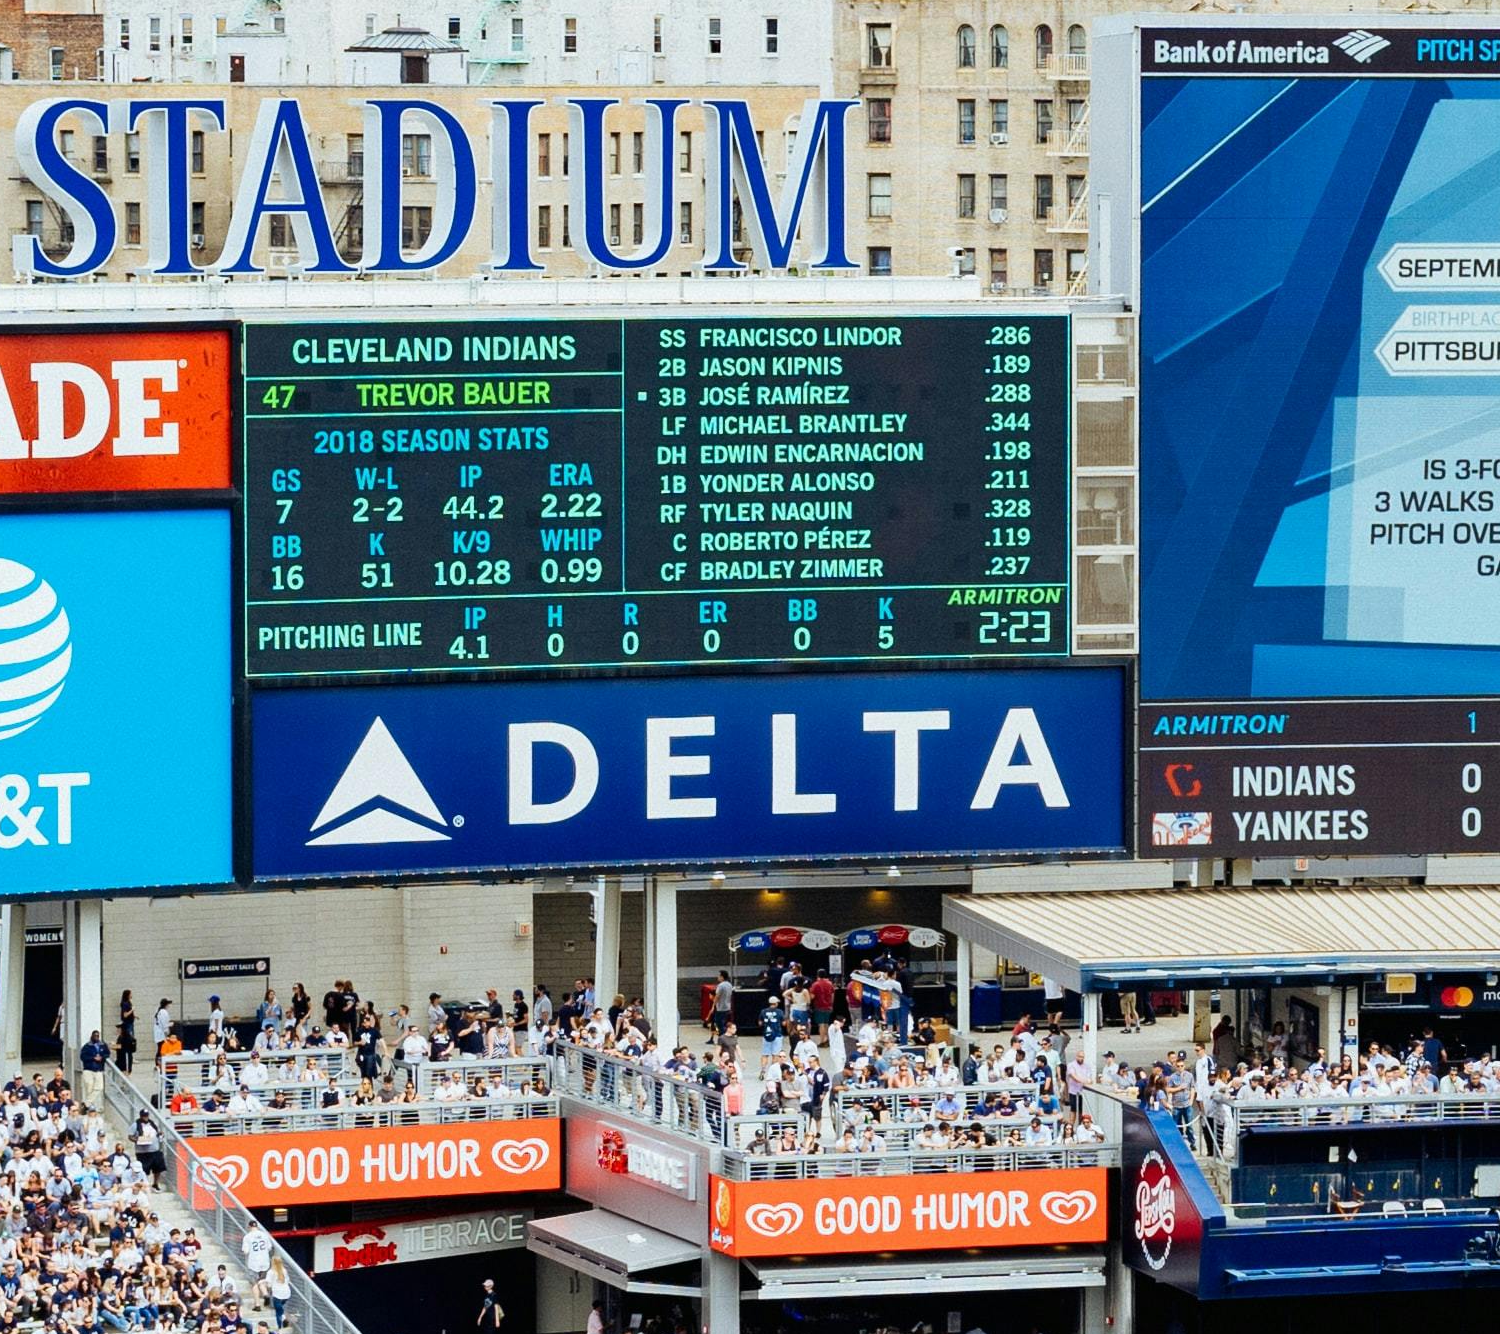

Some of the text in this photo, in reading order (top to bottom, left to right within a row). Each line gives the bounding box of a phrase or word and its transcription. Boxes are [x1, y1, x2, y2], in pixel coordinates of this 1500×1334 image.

[20, 99, 860, 275] STADIUM
[700, 327, 902, 348] FRANCISCO LINDOR
[292, 336, 577, 364] CLEVELAND INDIANS
[699, 356, 843, 377] JASON KIPNIS
[262, 381, 550, 408] 47 TREVOR BAUER
[699, 382, 850, 406] JOSÉ RAMÍREZ
[700, 413, 906, 435] MICHAEL BRANTLEY
[700, 442, 924, 464] EDWIN ENCARNACION
[700, 472, 874, 493] YONDER ALONSO
[700, 501, 852, 523] TYLER NAQUIN
[700, 526, 871, 551] ROBERTO PÉREZ
[700, 559, 883, 581] BRADLEY ZIMMER
[508, 706, 1070, 826] DELTA
[1232, 765, 1356, 796] INDIANS
[1232, 809, 1369, 841] YANKEES
[25, 933, 58, 943] WOMEN
[261, 1139, 481, 1189] GOOD HUMOR
[404, 1215, 524, 1254] TERRACE
